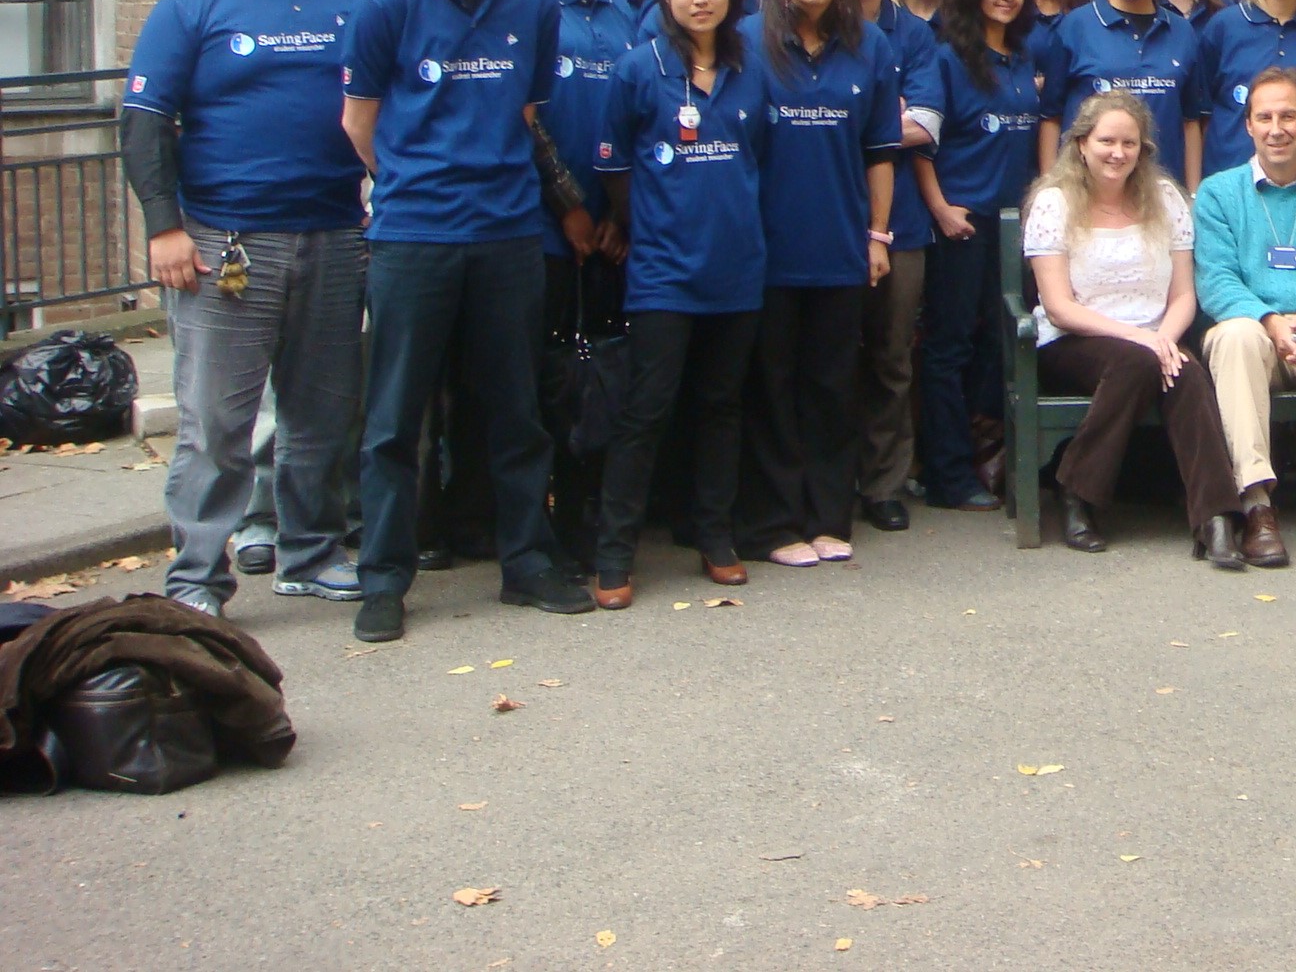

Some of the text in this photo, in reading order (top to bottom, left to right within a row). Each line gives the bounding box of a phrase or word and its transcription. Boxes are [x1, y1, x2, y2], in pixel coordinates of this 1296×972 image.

[257, 31, 336, 46] SavingFaces
[442, 57, 514, 73] SavingFaces
[1112, 76, 1176, 89] SavingFaces
[780, 106, 849, 119] SavingFaces
